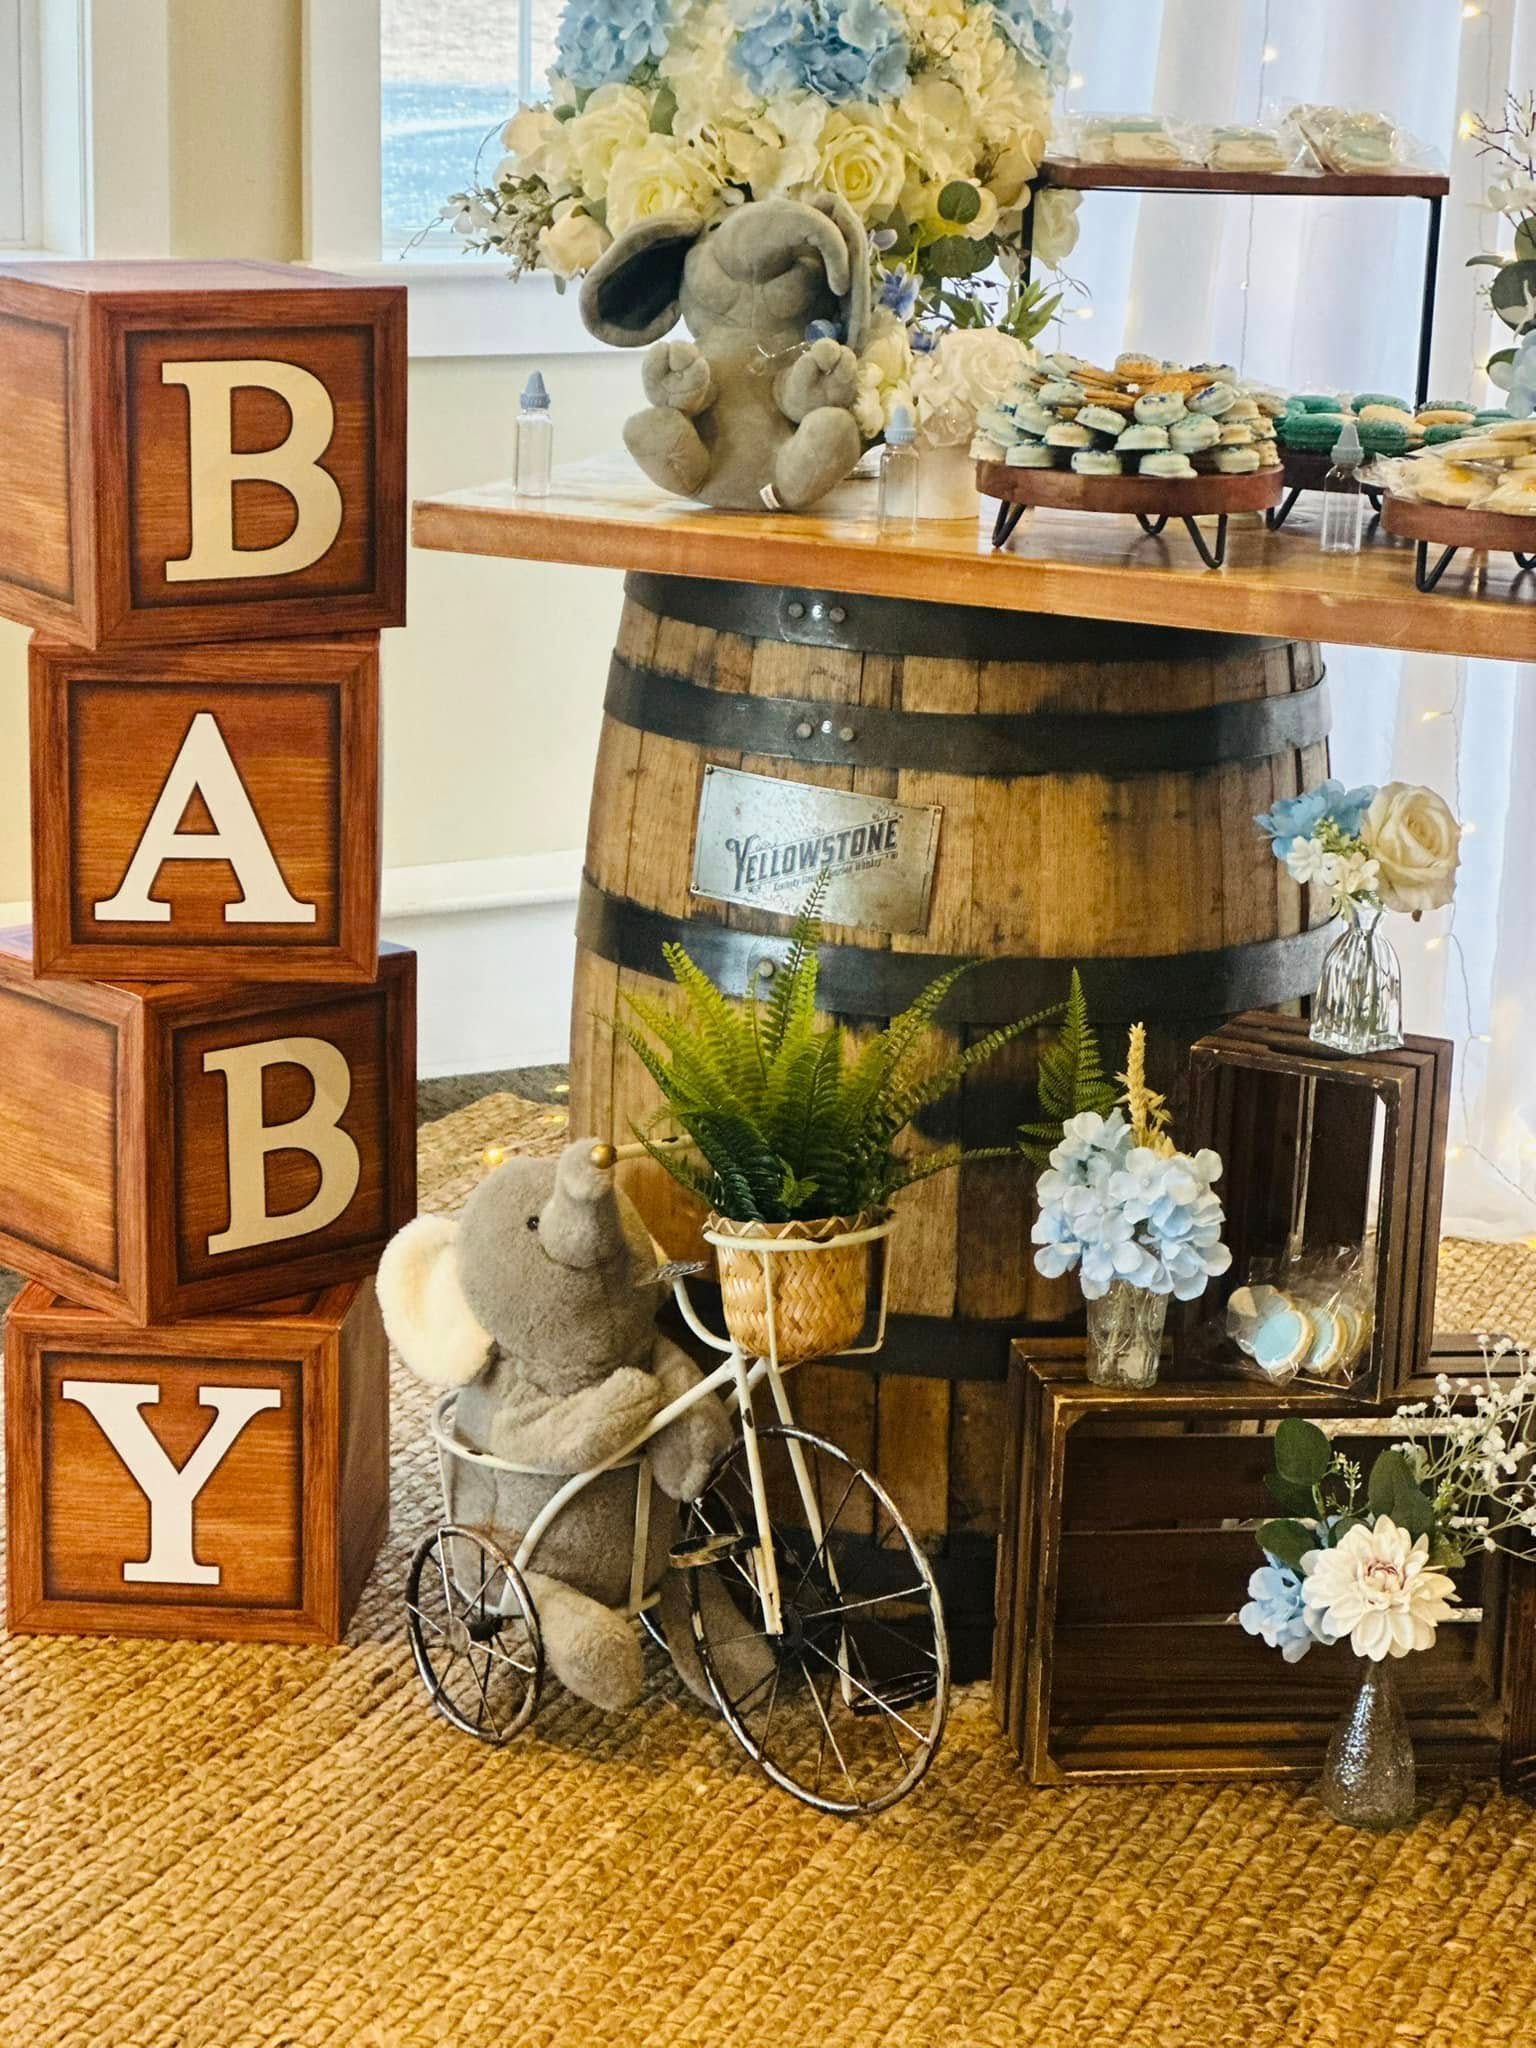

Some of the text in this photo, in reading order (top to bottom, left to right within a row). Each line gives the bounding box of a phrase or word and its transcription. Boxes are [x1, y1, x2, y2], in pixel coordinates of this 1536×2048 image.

[162, 360, 343, 583] B
[94, 712, 317, 924] A
[725, 819, 900, 893] YELLOWSTONE
[203, 1037, 361, 1256] B
[62, 1380, 283, 1586] Y
